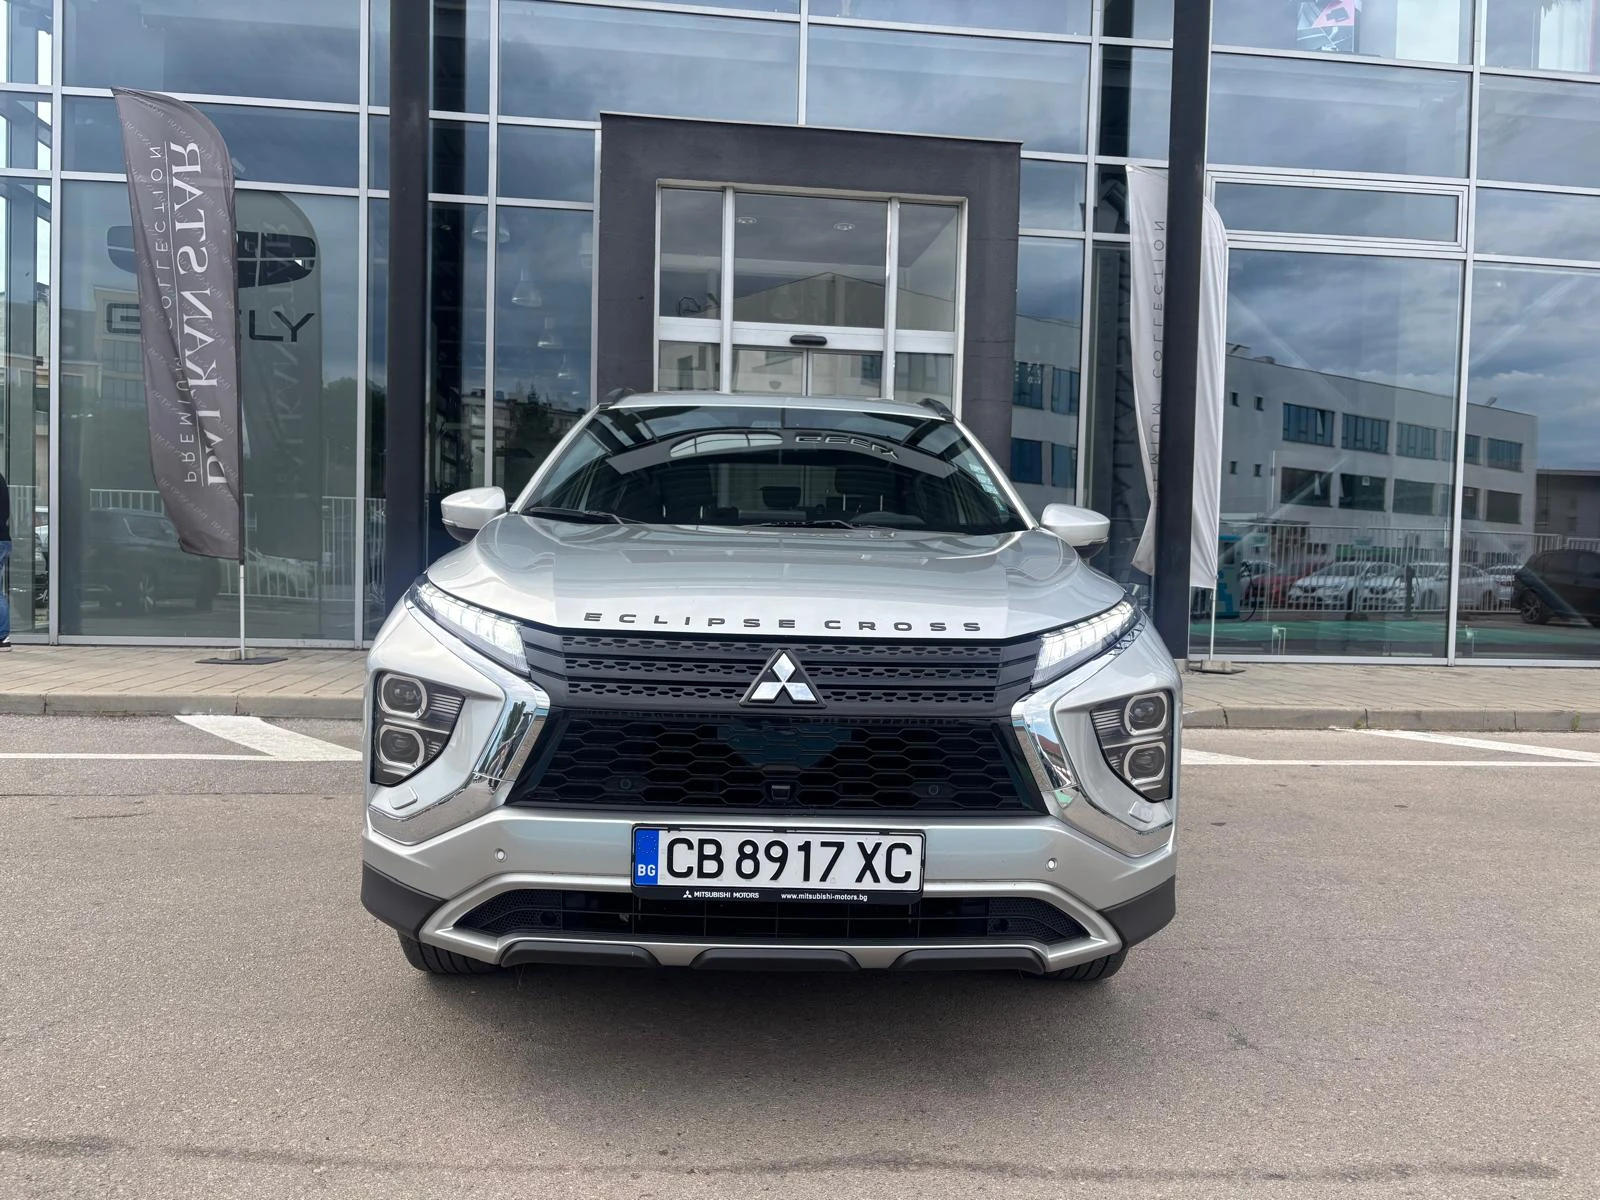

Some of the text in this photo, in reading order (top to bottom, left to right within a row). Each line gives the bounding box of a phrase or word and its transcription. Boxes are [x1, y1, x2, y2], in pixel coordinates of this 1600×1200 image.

[107, 303, 315, 343] GLY
[584, 612, 982, 632] ECLIPSE CROSS
[667, 837, 913, 884] CB 8917 XC
[637, 864, 656, 877] BG
[693, 891, 731, 899] MITSUBISHI
[781, 893, 868, 902] www.mitsubishi-motors.bg
